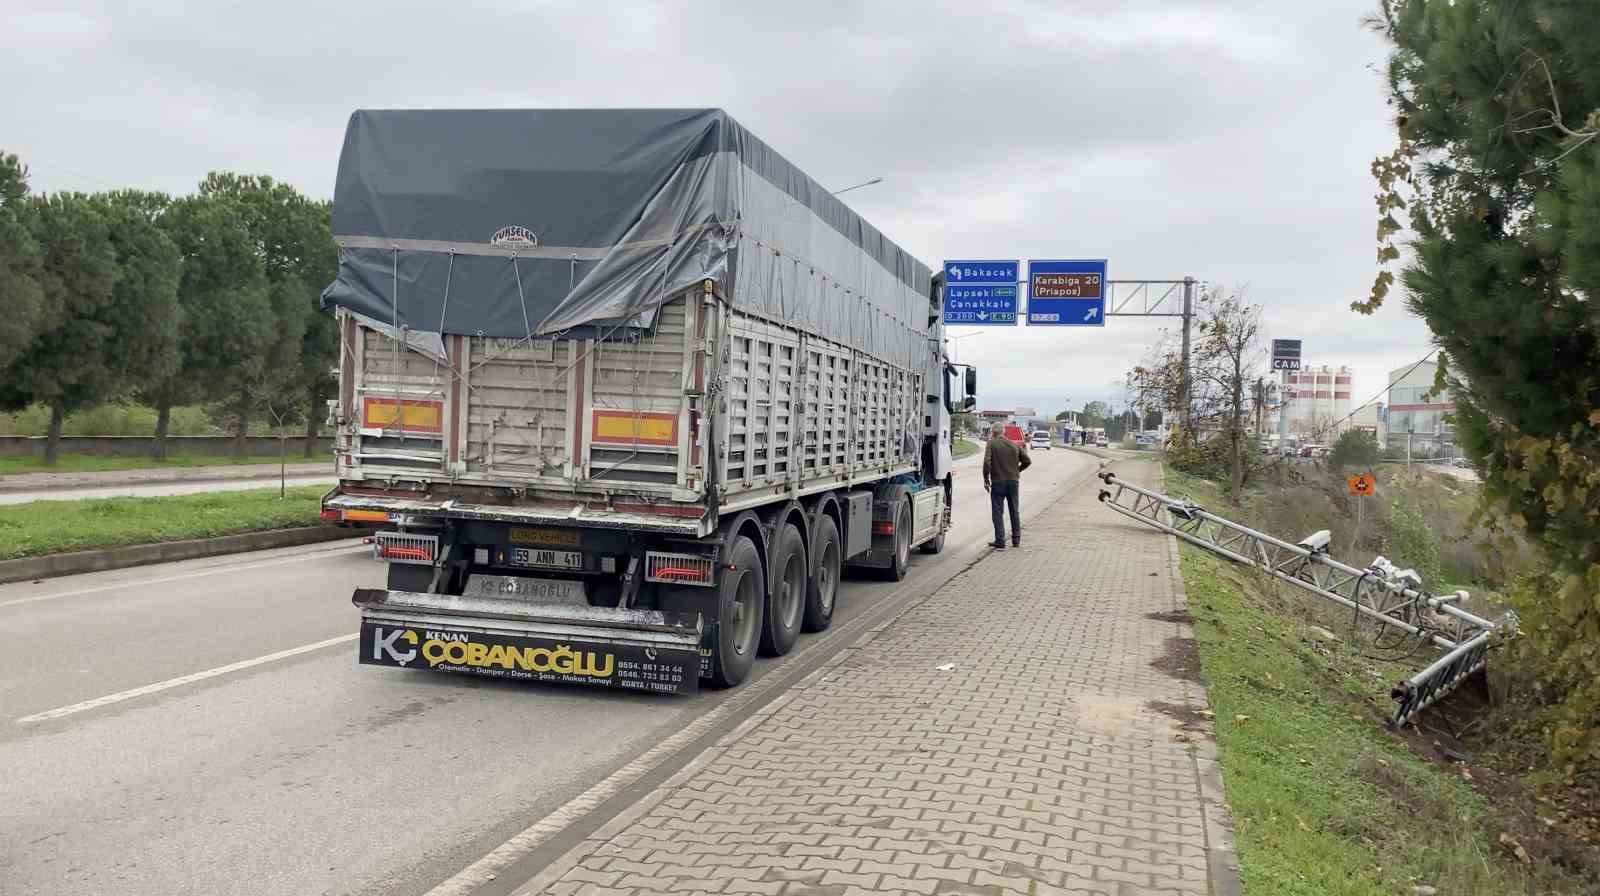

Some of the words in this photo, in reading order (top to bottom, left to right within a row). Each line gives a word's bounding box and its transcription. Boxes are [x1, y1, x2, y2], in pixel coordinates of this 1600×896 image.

[964, 269, 1012, 277] Bakacak
[1086, 276, 1099, 285] 20
[950, 289, 994, 299] Lapseki
[950, 300, 1011, 309] Çanakkale
[1274, 360, 1299, 369] CAM
[516, 551, 528, 562] 59
[536, 552, 555, 564] ANN
[425, 631, 468, 642] KENAN
[422, 640, 614, 677] ÇOBANOĞLU
